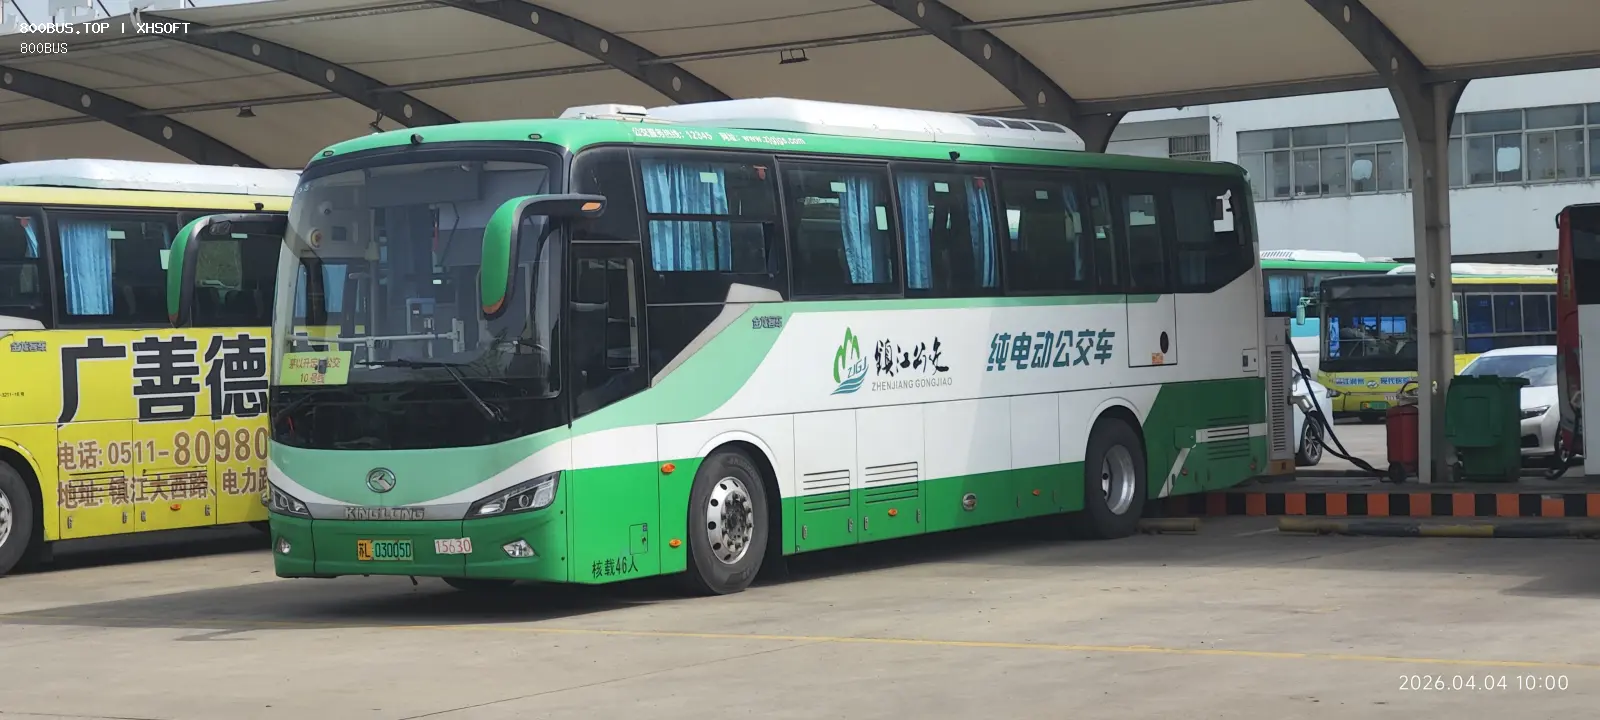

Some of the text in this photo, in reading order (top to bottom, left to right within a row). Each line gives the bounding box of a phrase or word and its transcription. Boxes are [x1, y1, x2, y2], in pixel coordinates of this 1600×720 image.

[686, 130, 713, 140] 12345
[986, 328, 1116, 372] 纯电动公交车
[57, 333, 268, 428] 广善德
[872, 377, 953, 391] ZHENJIANG GONGJIAO
[436, 540, 471, 553] 15630
[591, 555, 638, 579] 核载46人
